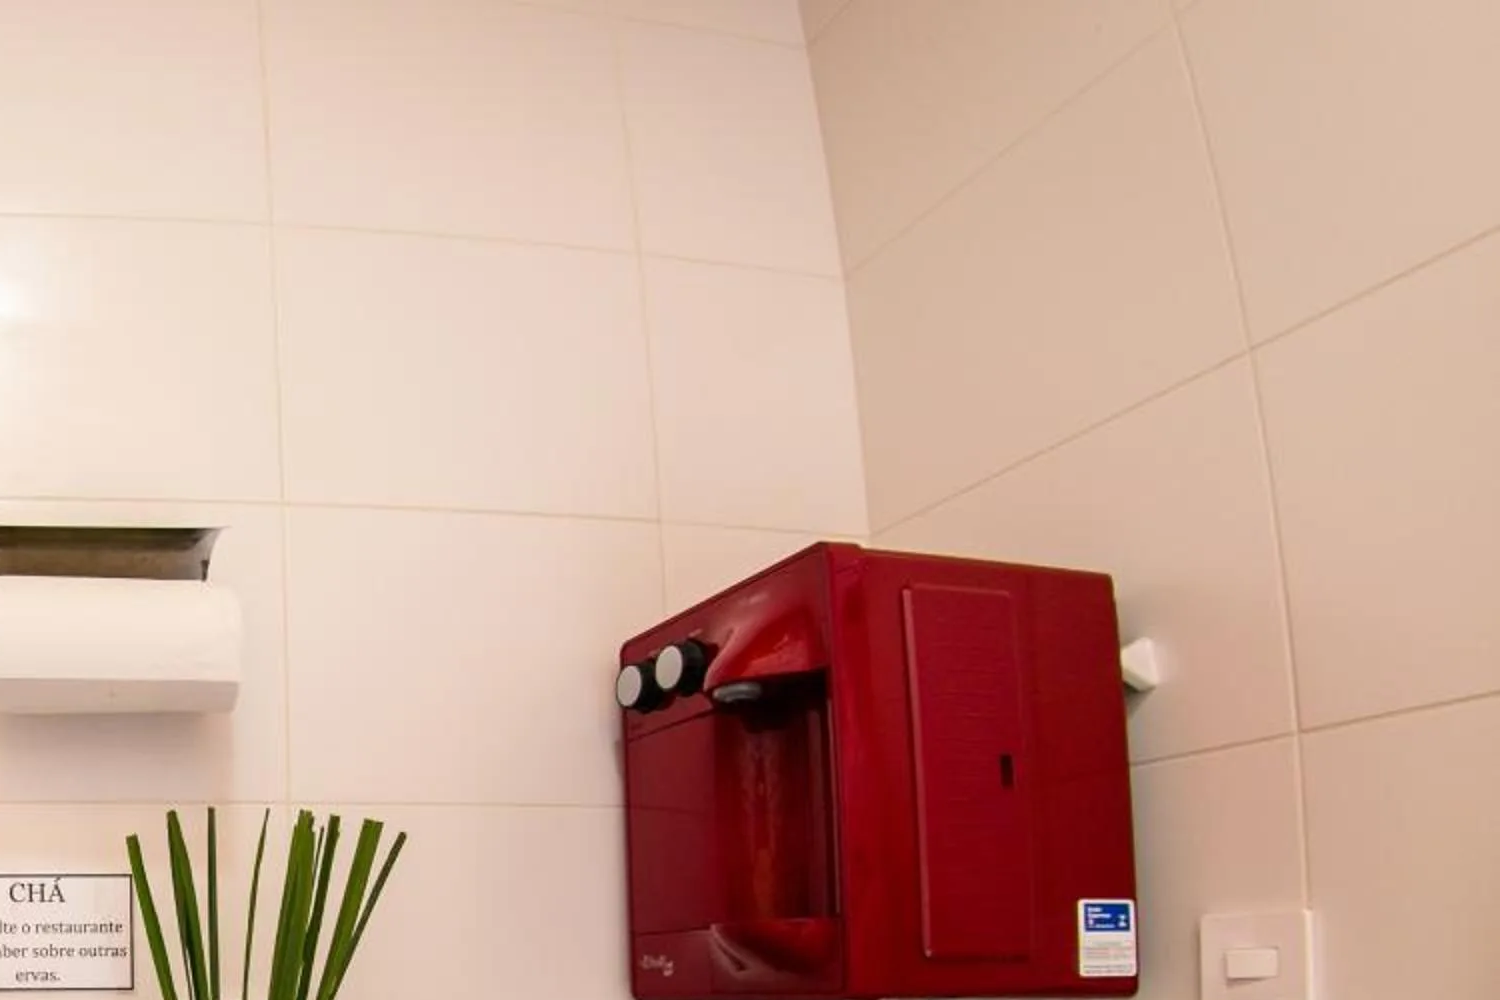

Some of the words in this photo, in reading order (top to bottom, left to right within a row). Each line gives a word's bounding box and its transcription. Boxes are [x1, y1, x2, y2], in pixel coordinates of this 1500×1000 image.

[8, 876, 66, 903] CHÁ
[21, 923, 32, 935] o
[35, 920, 124, 935] restaurante
[32, 943, 75, 959] sobre
[78, 946, 129, 958] outras
[15, 970, 62, 983] ervas.
